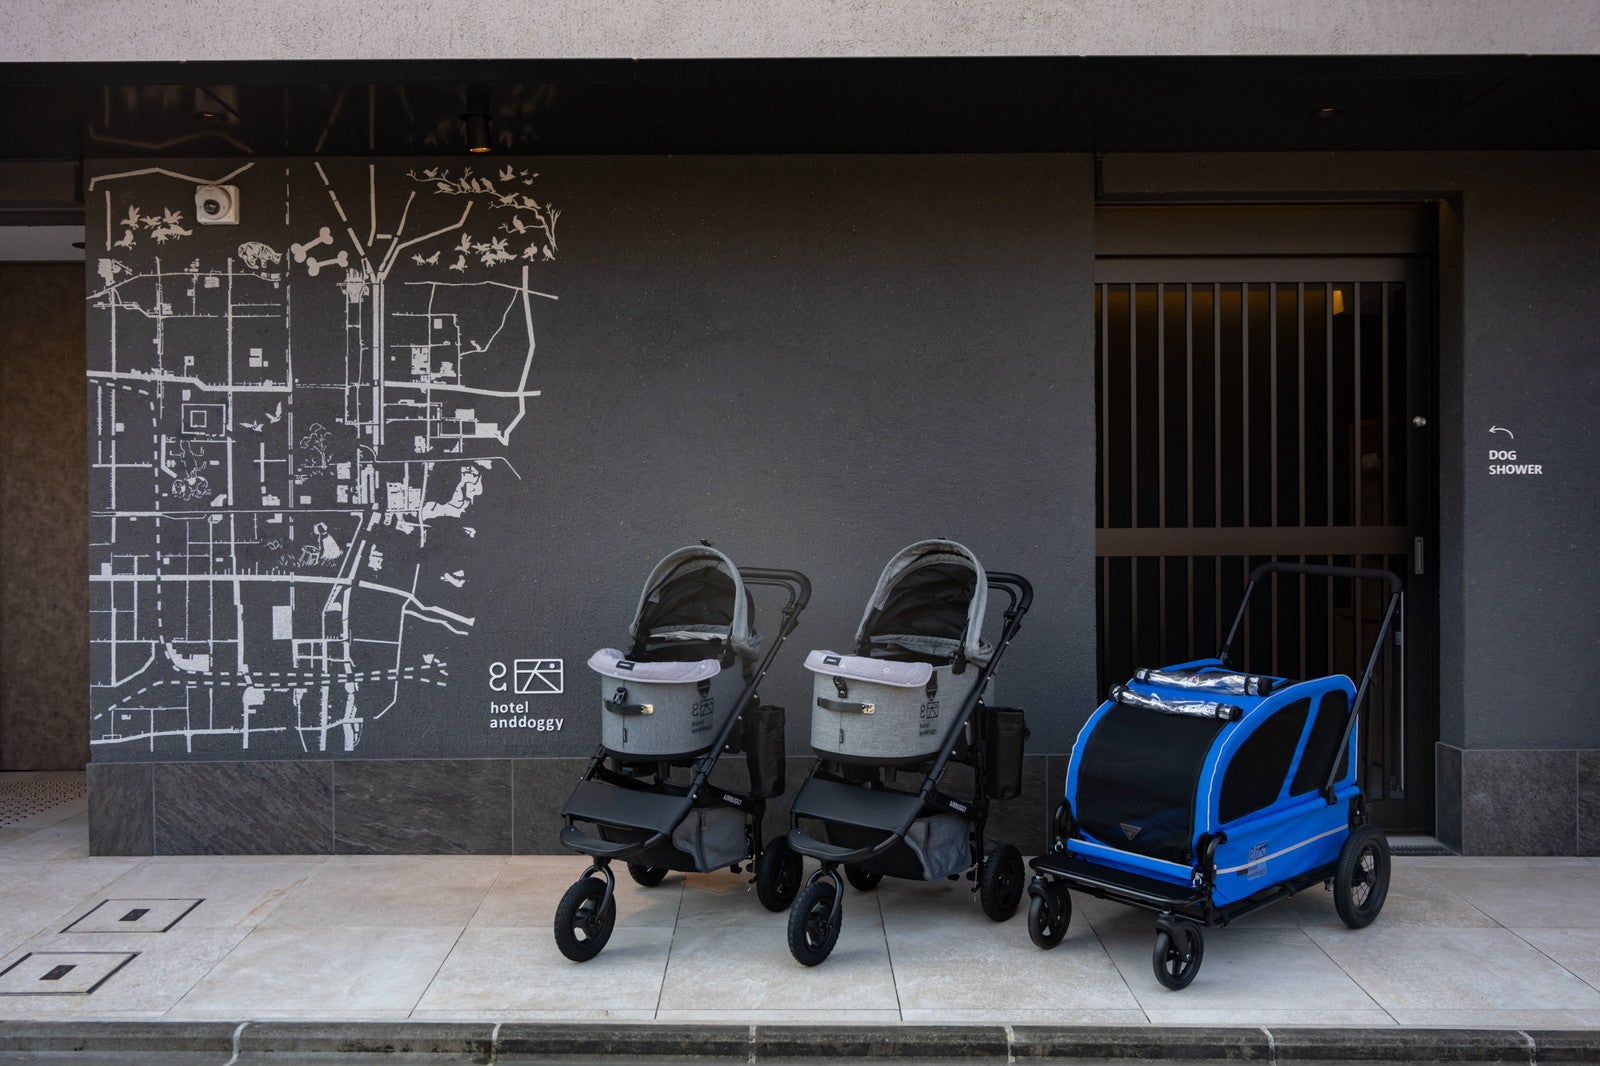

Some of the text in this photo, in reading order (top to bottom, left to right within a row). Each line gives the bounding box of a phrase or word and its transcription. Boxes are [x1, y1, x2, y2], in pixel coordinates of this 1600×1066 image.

[1488, 450, 1517, 461] DOG
[1488, 464, 1543, 476] SHOWER
[490, 701, 529, 714] hotel
[490, 715, 564, 732] anddoggy
